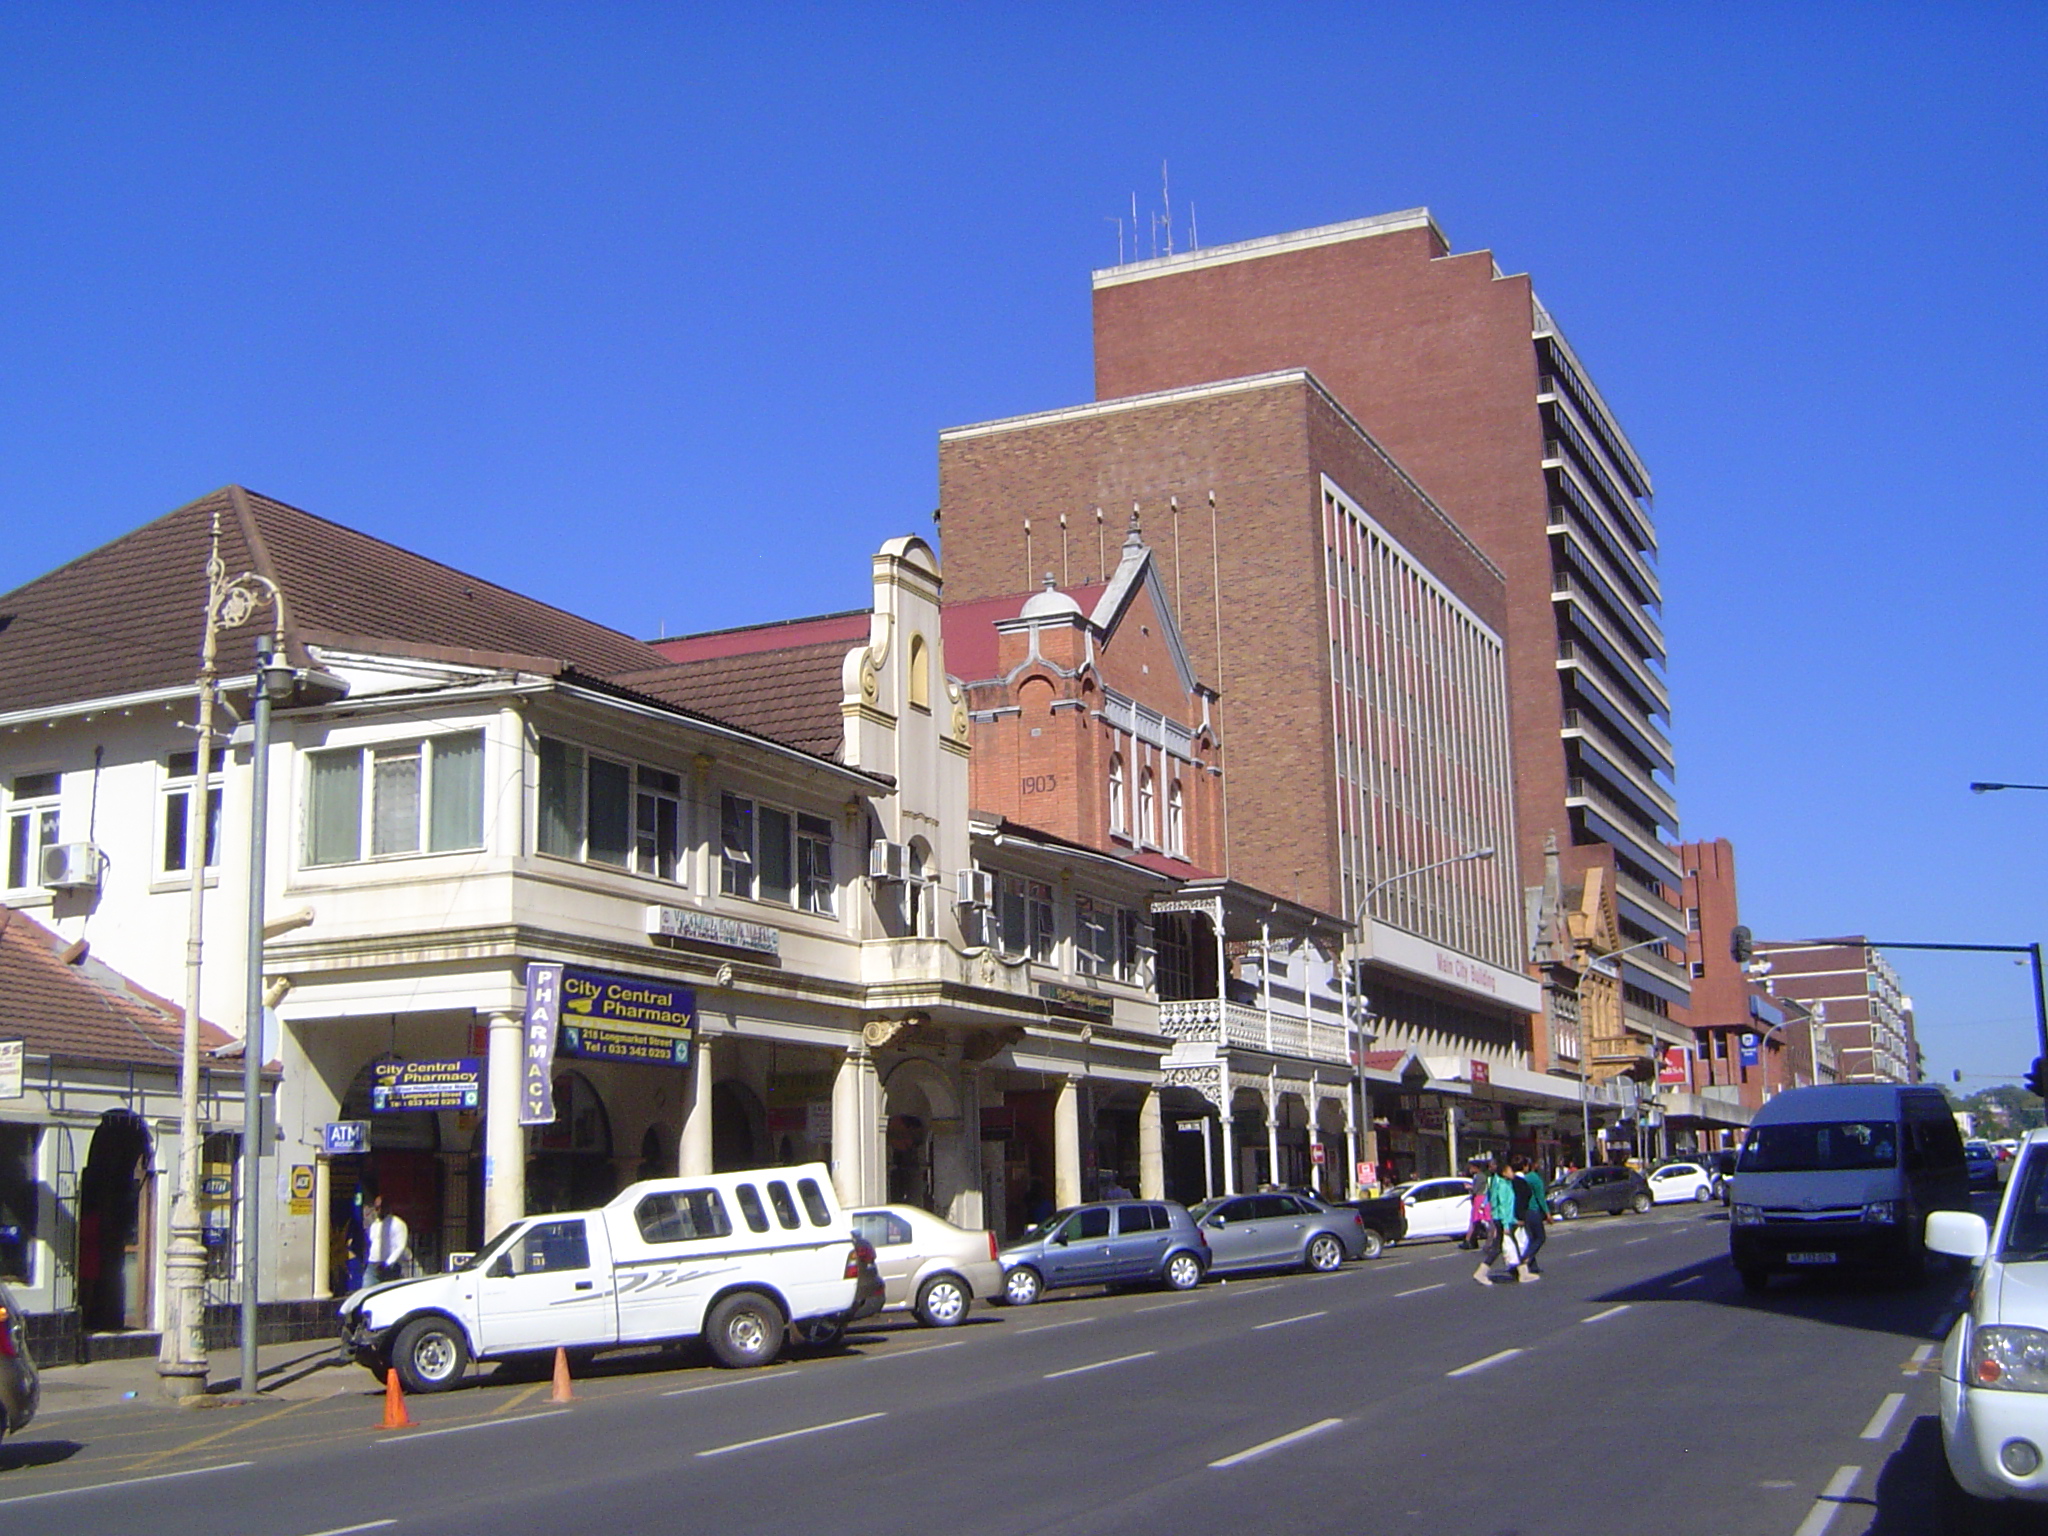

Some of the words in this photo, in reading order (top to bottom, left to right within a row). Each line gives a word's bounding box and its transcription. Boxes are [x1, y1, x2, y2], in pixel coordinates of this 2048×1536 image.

[1022, 774, 1057, 795] 1903
[564, 978, 602, 1000] City
[606, 985, 673, 1006] Central
[603, 1000, 691, 1027] Pharmacy
[528, 970, 553, 1116] PHARMACY
[584, 1041, 600, 1053] Tel
[608, 1044, 627, 1055] 033
[629, 1046, 647, 1057] 342
[375, 1065, 404, 1075] City
[407, 1062, 460, 1073] Central
[403, 1073, 478, 1082] Pharmacy
[330, 1125, 360, 1142] ATM
